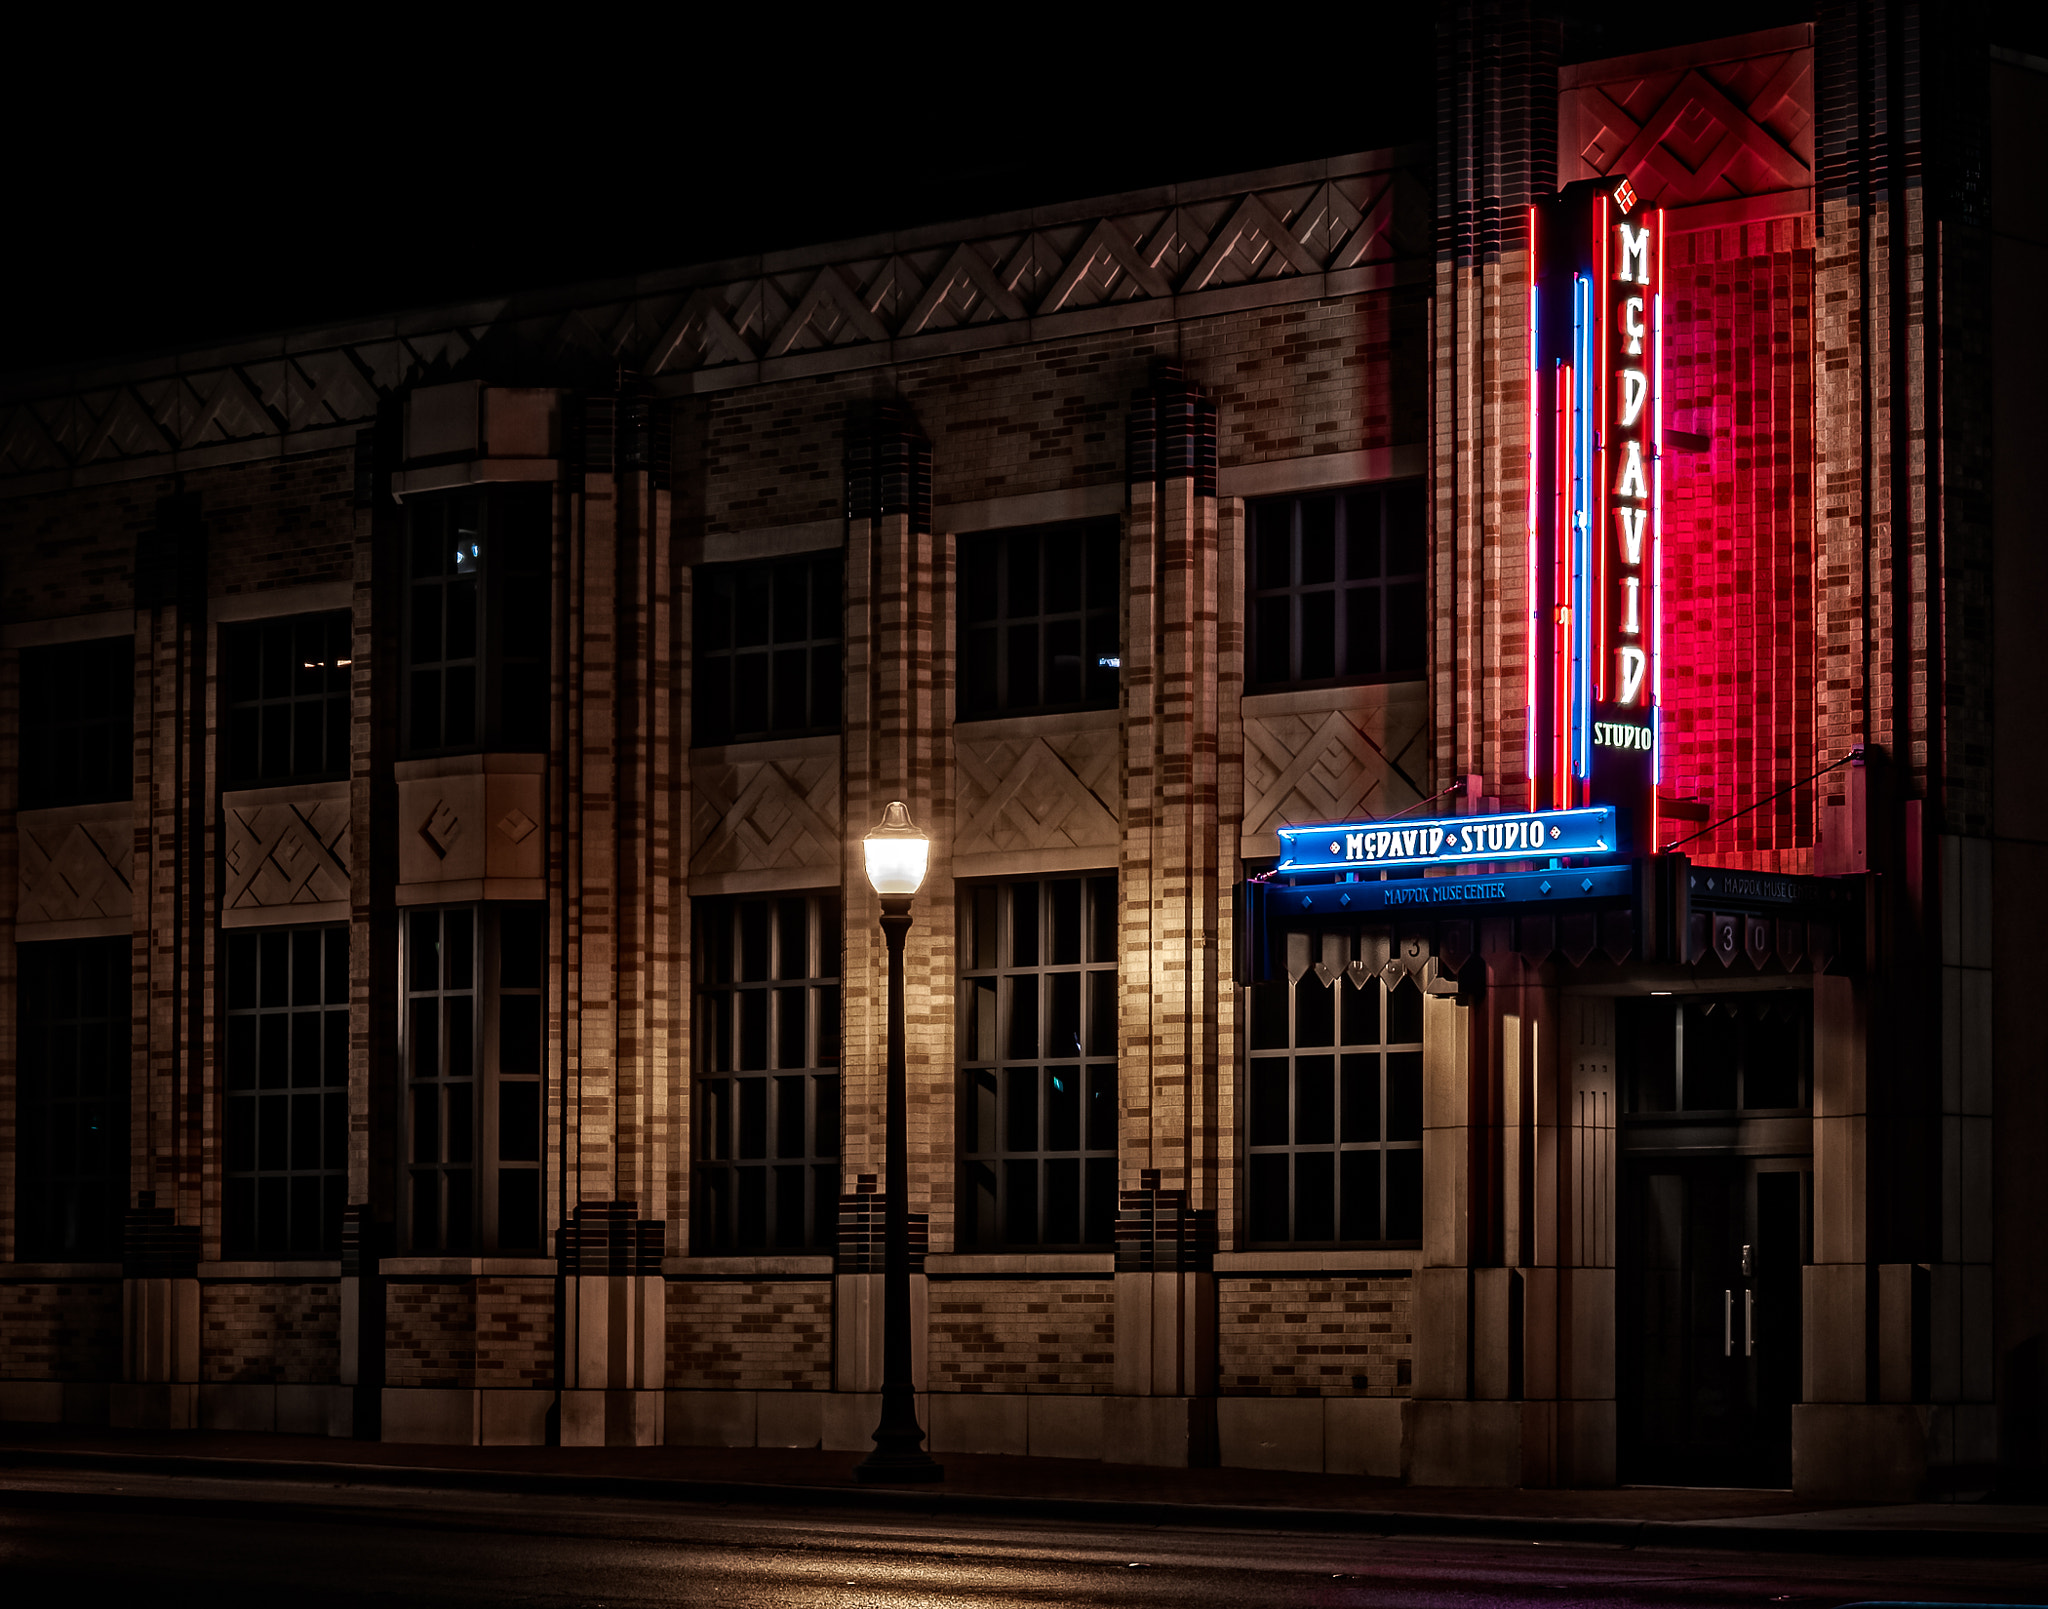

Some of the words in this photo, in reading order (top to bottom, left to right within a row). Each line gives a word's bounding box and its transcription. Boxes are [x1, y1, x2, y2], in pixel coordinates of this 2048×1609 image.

[1594, 722, 1652, 750] STUDIO
[1460, 820, 1545, 853] STUDIO
[1384, 887, 1430, 906] MADDOX
[1433, 885, 1463, 902] MUSE
[1464, 883, 1506, 901] CENTER
[1724, 877, 1761, 897] MADDOX
[1763, 881, 1787, 898] MUSE
